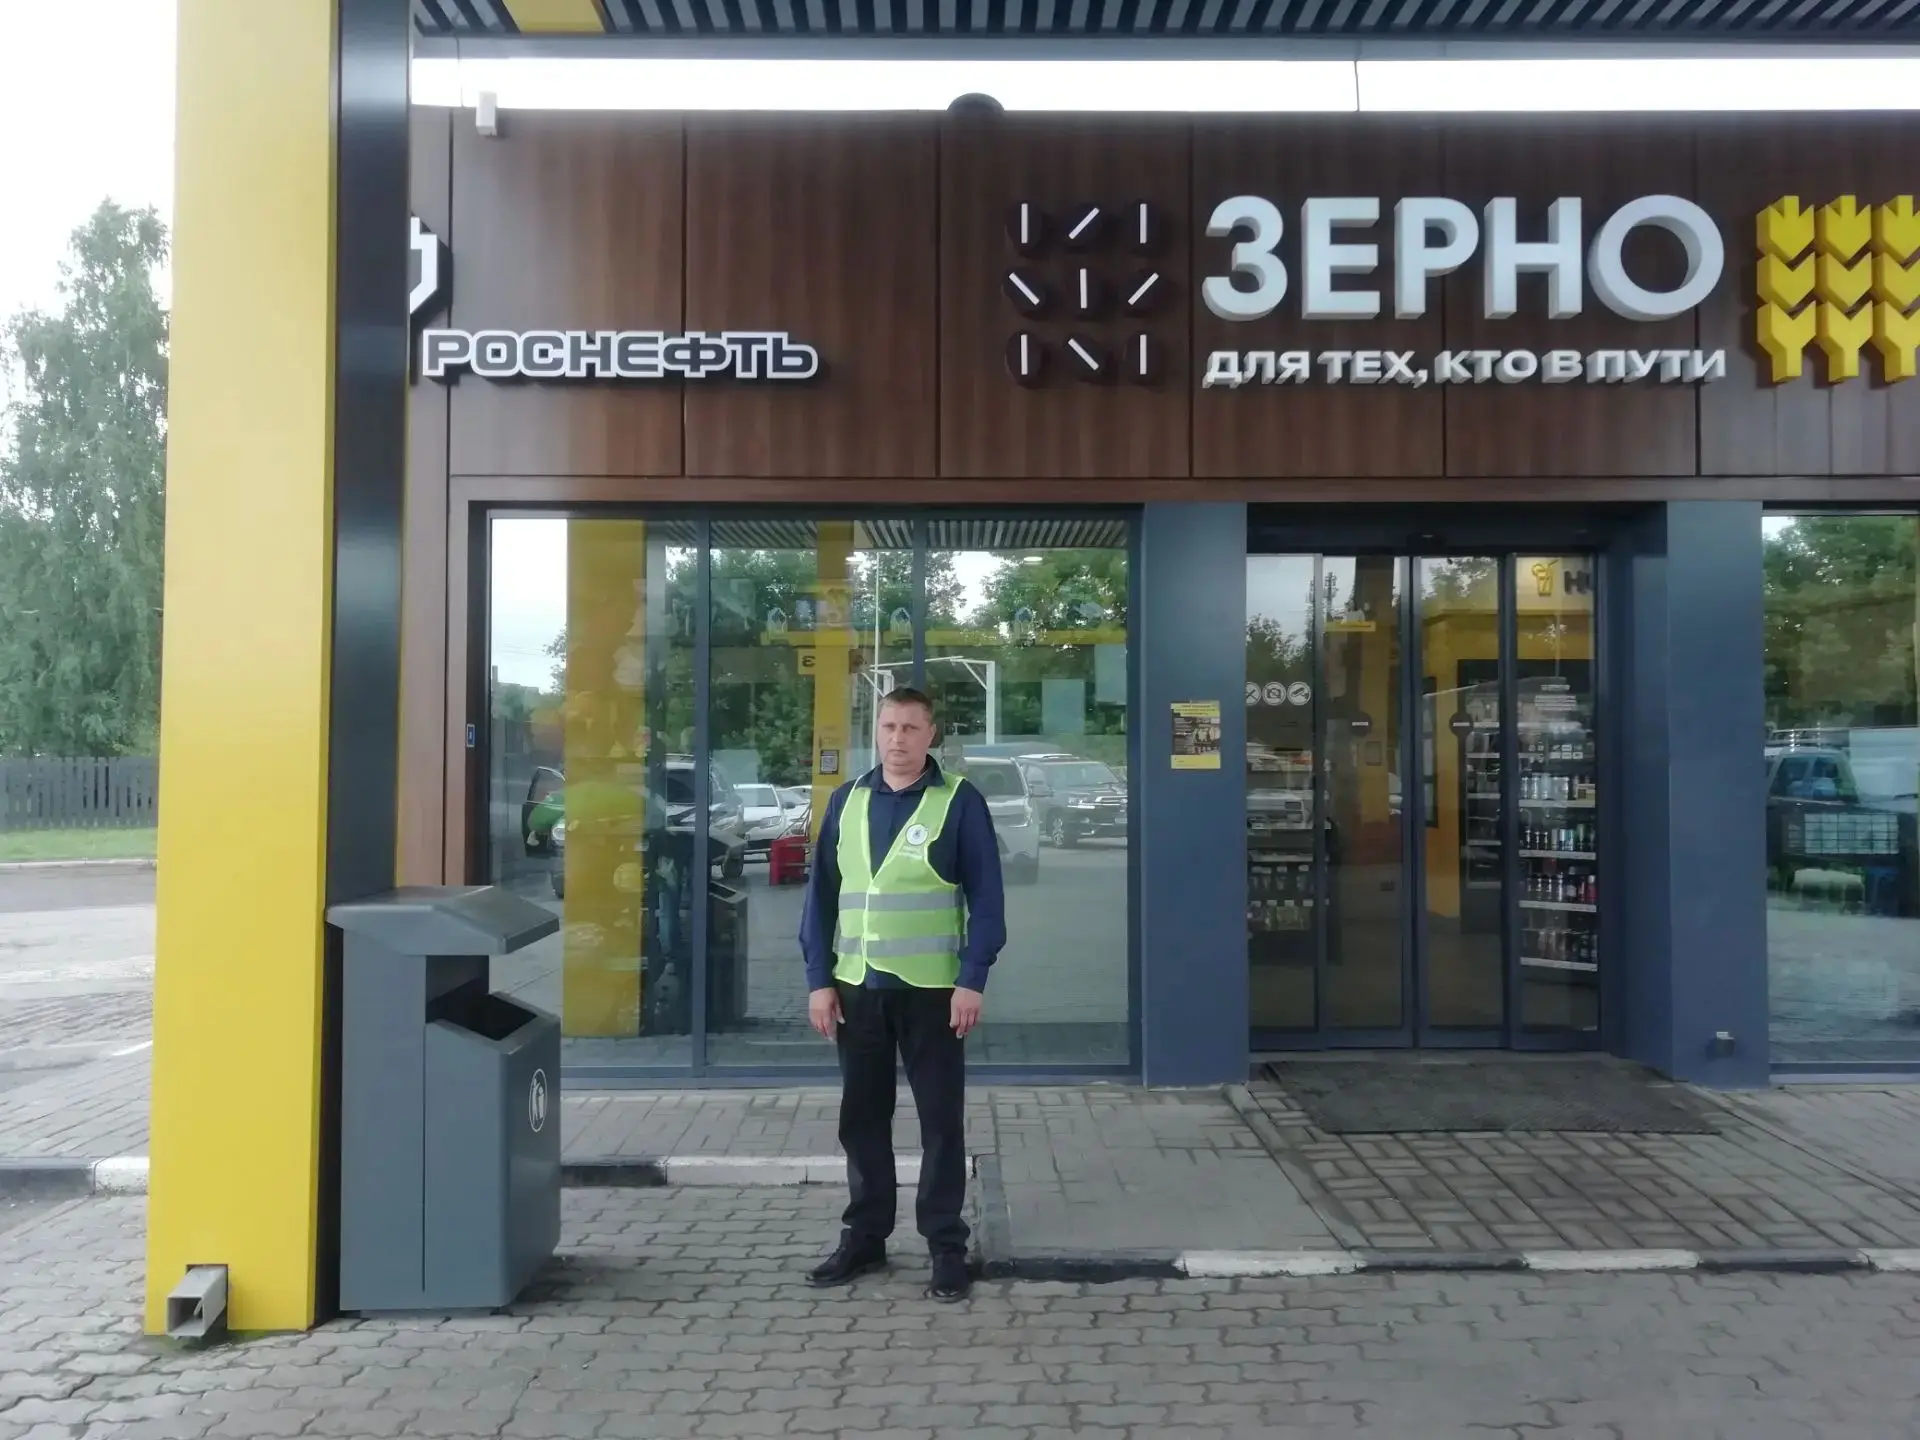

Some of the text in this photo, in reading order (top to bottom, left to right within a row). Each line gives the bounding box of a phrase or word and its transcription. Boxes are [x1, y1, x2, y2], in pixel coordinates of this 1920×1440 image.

[1203, 194, 1725, 321] ЗЕРНО
[422, 329, 819, 379] РОСНЕФТЬ
[1202, 349, 1726, 388] ДЛЯ ТЕХ, КТО В ПУТИ
